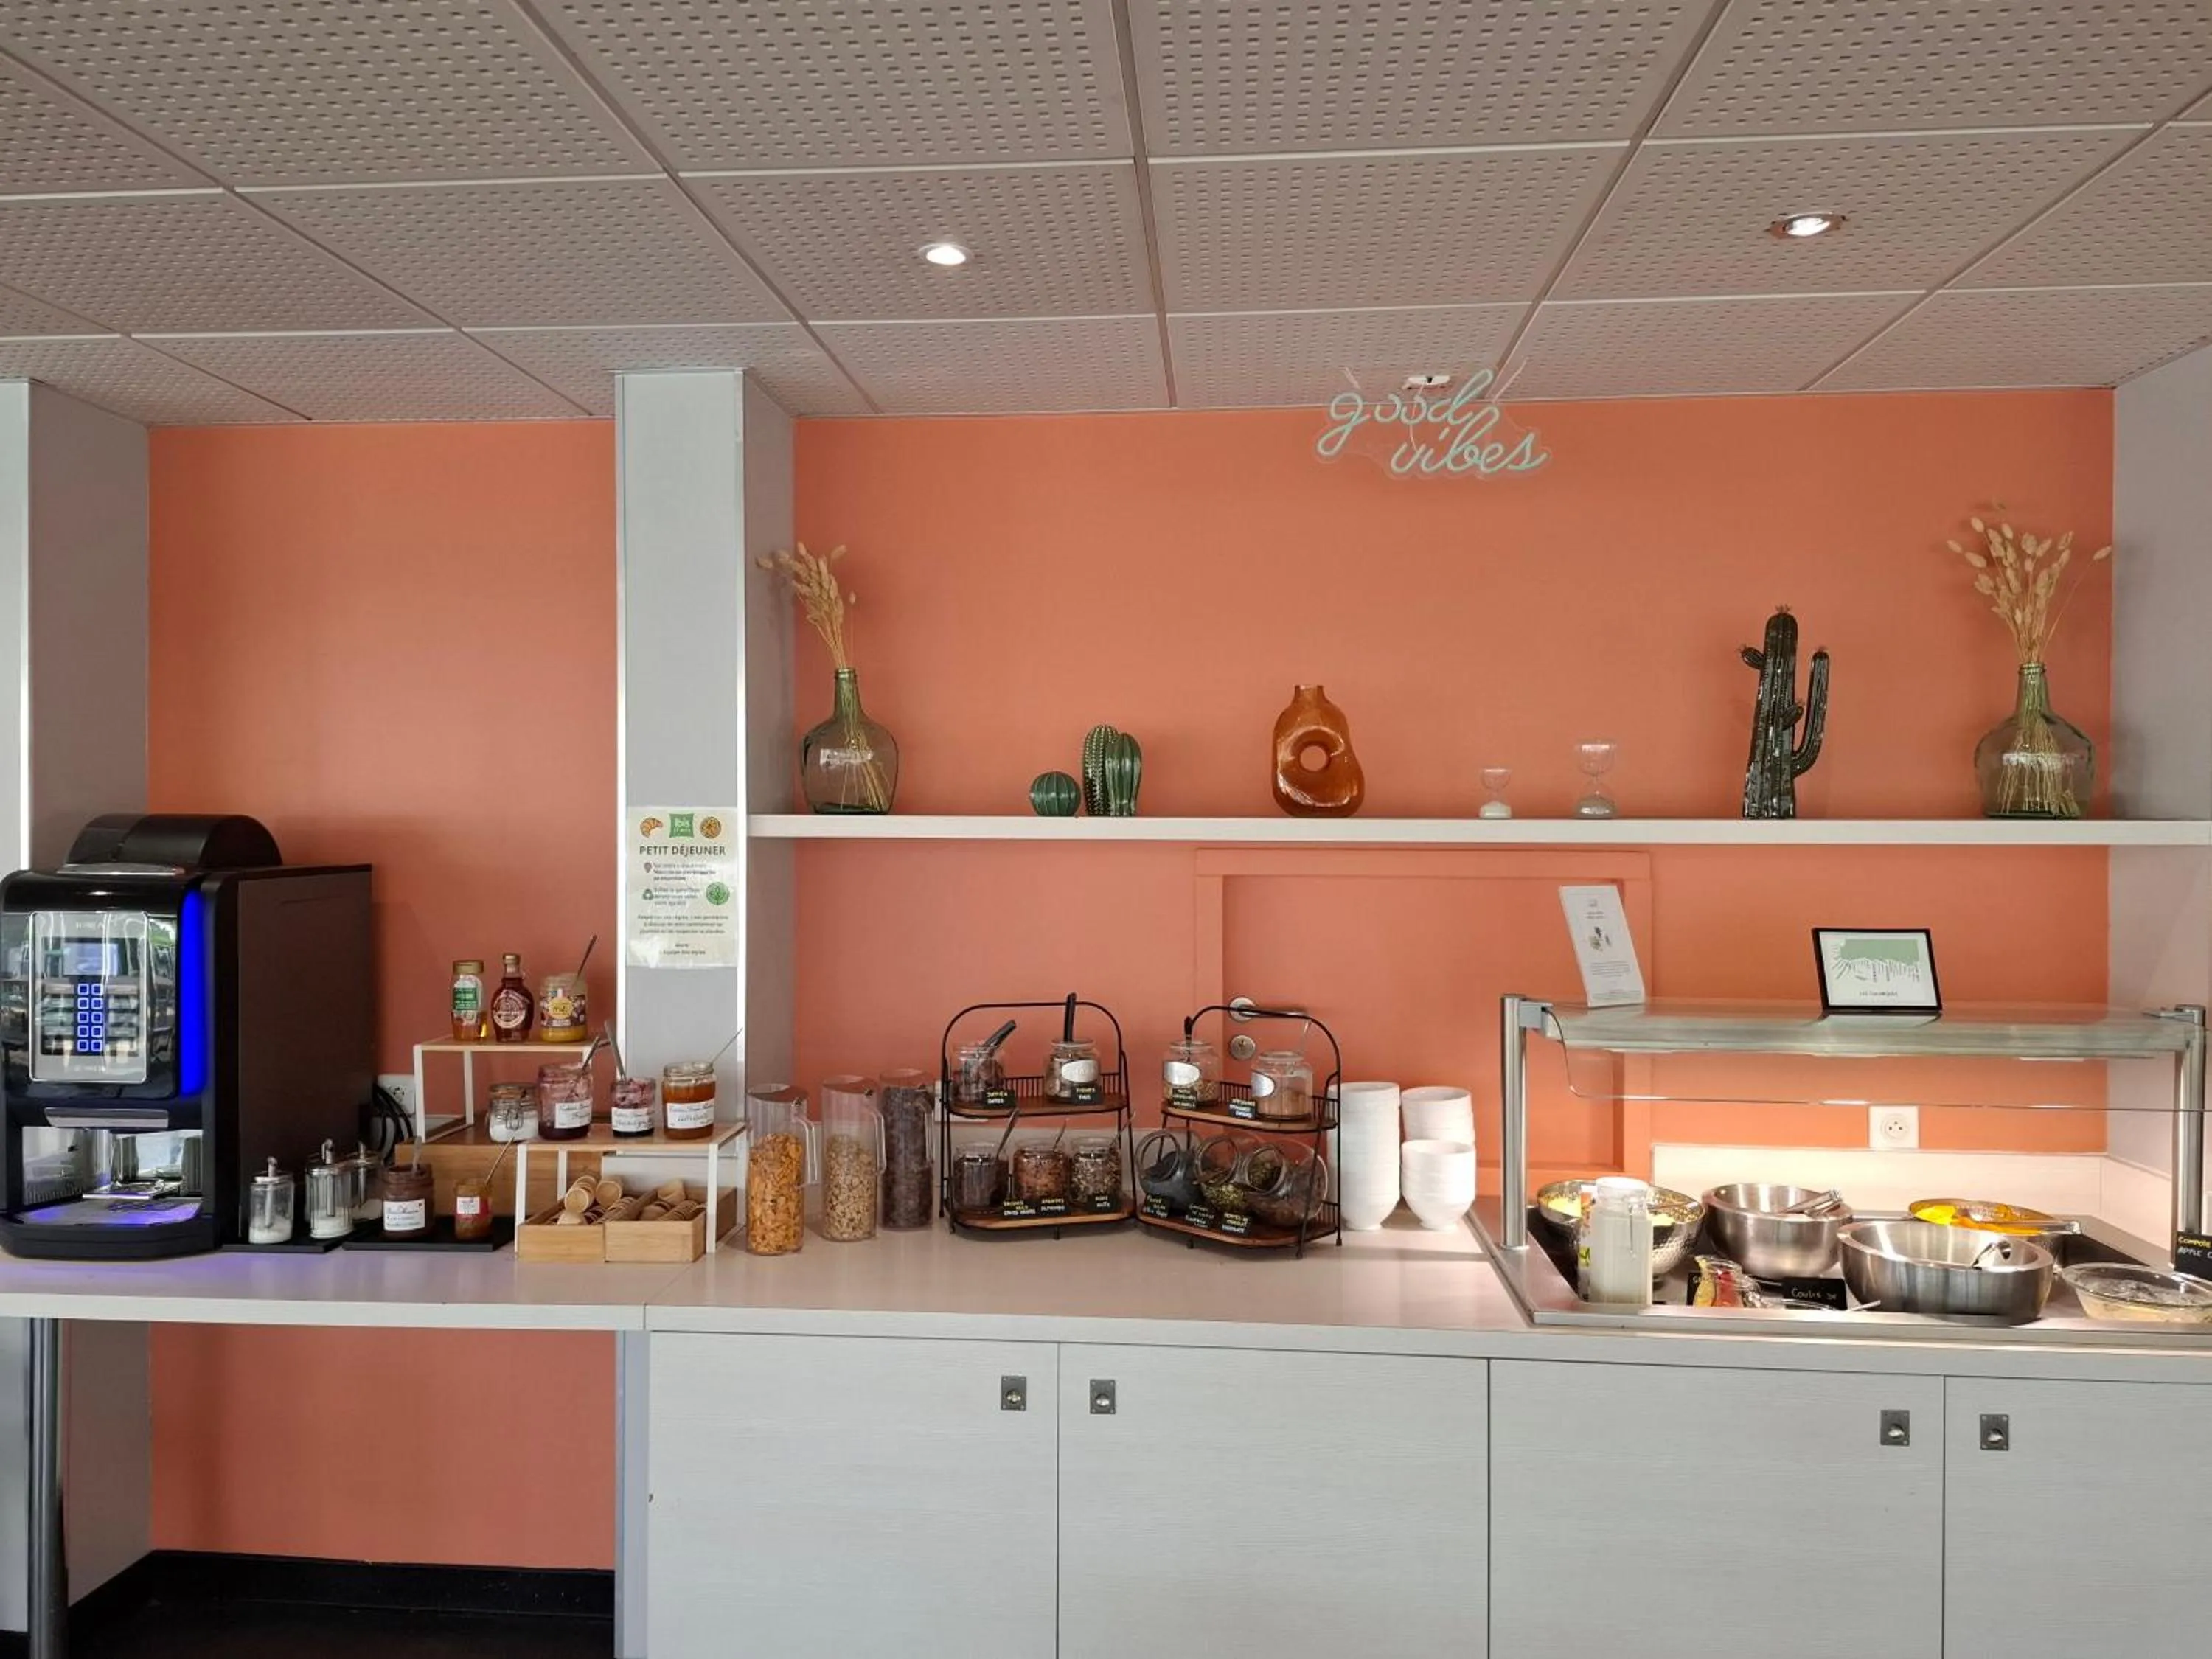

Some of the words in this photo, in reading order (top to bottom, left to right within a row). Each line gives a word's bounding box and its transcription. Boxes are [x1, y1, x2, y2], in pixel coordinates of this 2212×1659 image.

[1318, 369, 1494, 456] good
[1391, 406, 1548, 473] vibes
[639, 846, 669, 855] PETIT
[672, 844, 726, 857] DÉJEUNER
